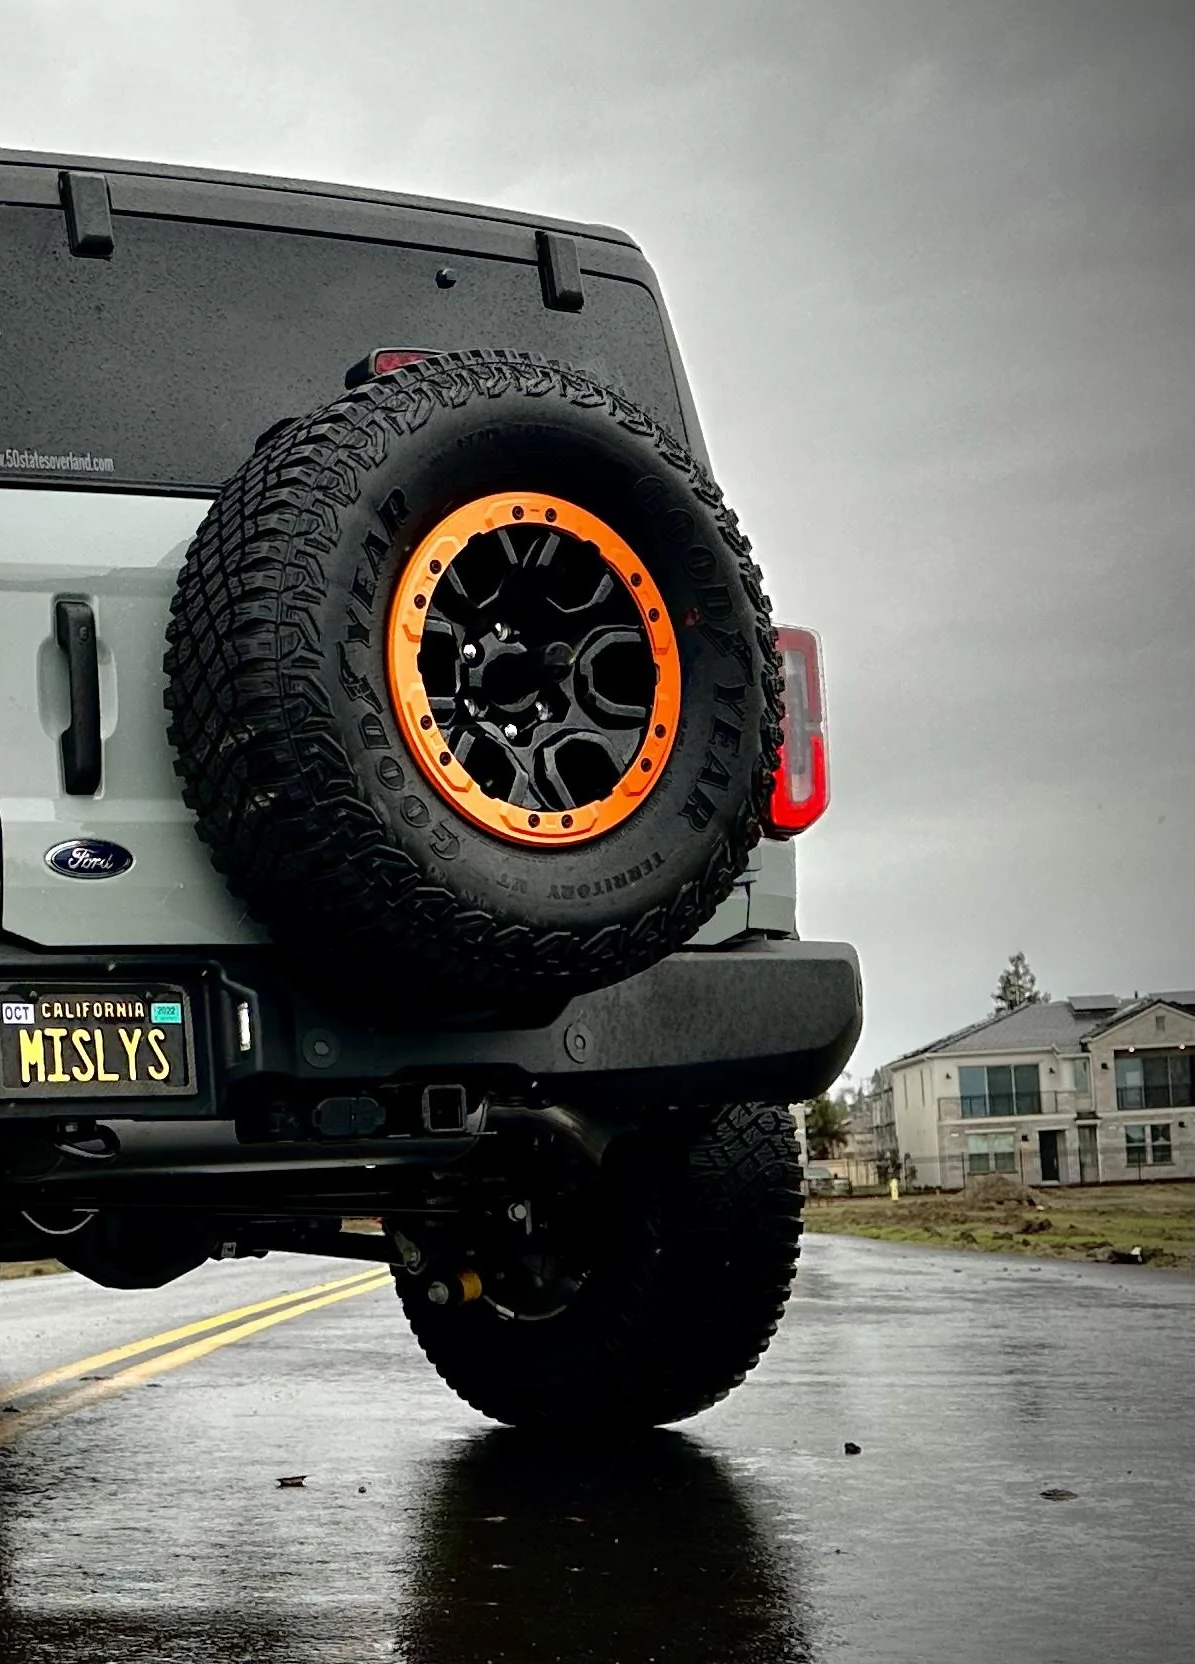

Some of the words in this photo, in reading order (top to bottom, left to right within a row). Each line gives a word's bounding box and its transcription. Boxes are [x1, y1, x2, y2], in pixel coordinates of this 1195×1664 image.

[68, 848, 114, 869] Ford
[547, 851, 666, 900] TERRITORY
[5, 1006, 30, 1021] OCT
[41, 1002, 145, 1019] CALIFORNIA
[157, 1006, 176, 1016] 2022
[19, 1028, 170, 1083] MISLYS
